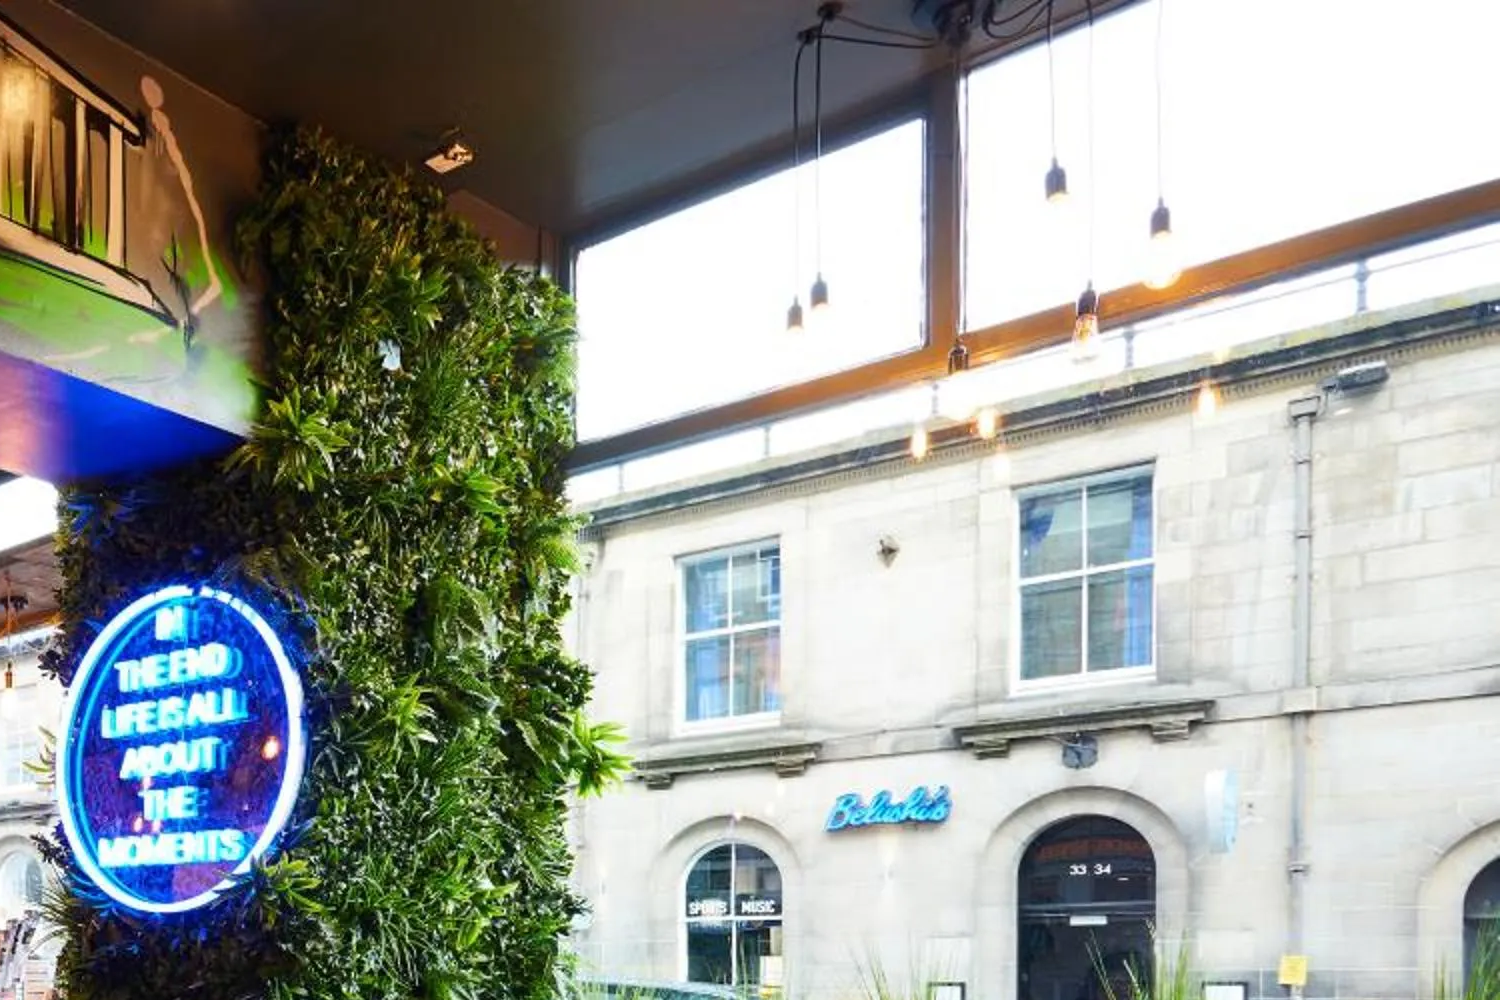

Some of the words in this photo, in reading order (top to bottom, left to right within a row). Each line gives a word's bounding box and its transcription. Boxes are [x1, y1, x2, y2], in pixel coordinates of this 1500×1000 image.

[114, 654, 169, 692] THE
[169, 642, 236, 685] END
[101, 700, 157, 739] LIFE
[157, 696, 185, 730] IS
[187, 686, 241, 727] ALL
[119, 737, 224, 779] ABOUT
[138, 785, 202, 821] THE
[97, 828, 248, 867] MOMENTS
[1069, 863, 1088, 876] 33
[1093, 863, 1112, 876] 34
